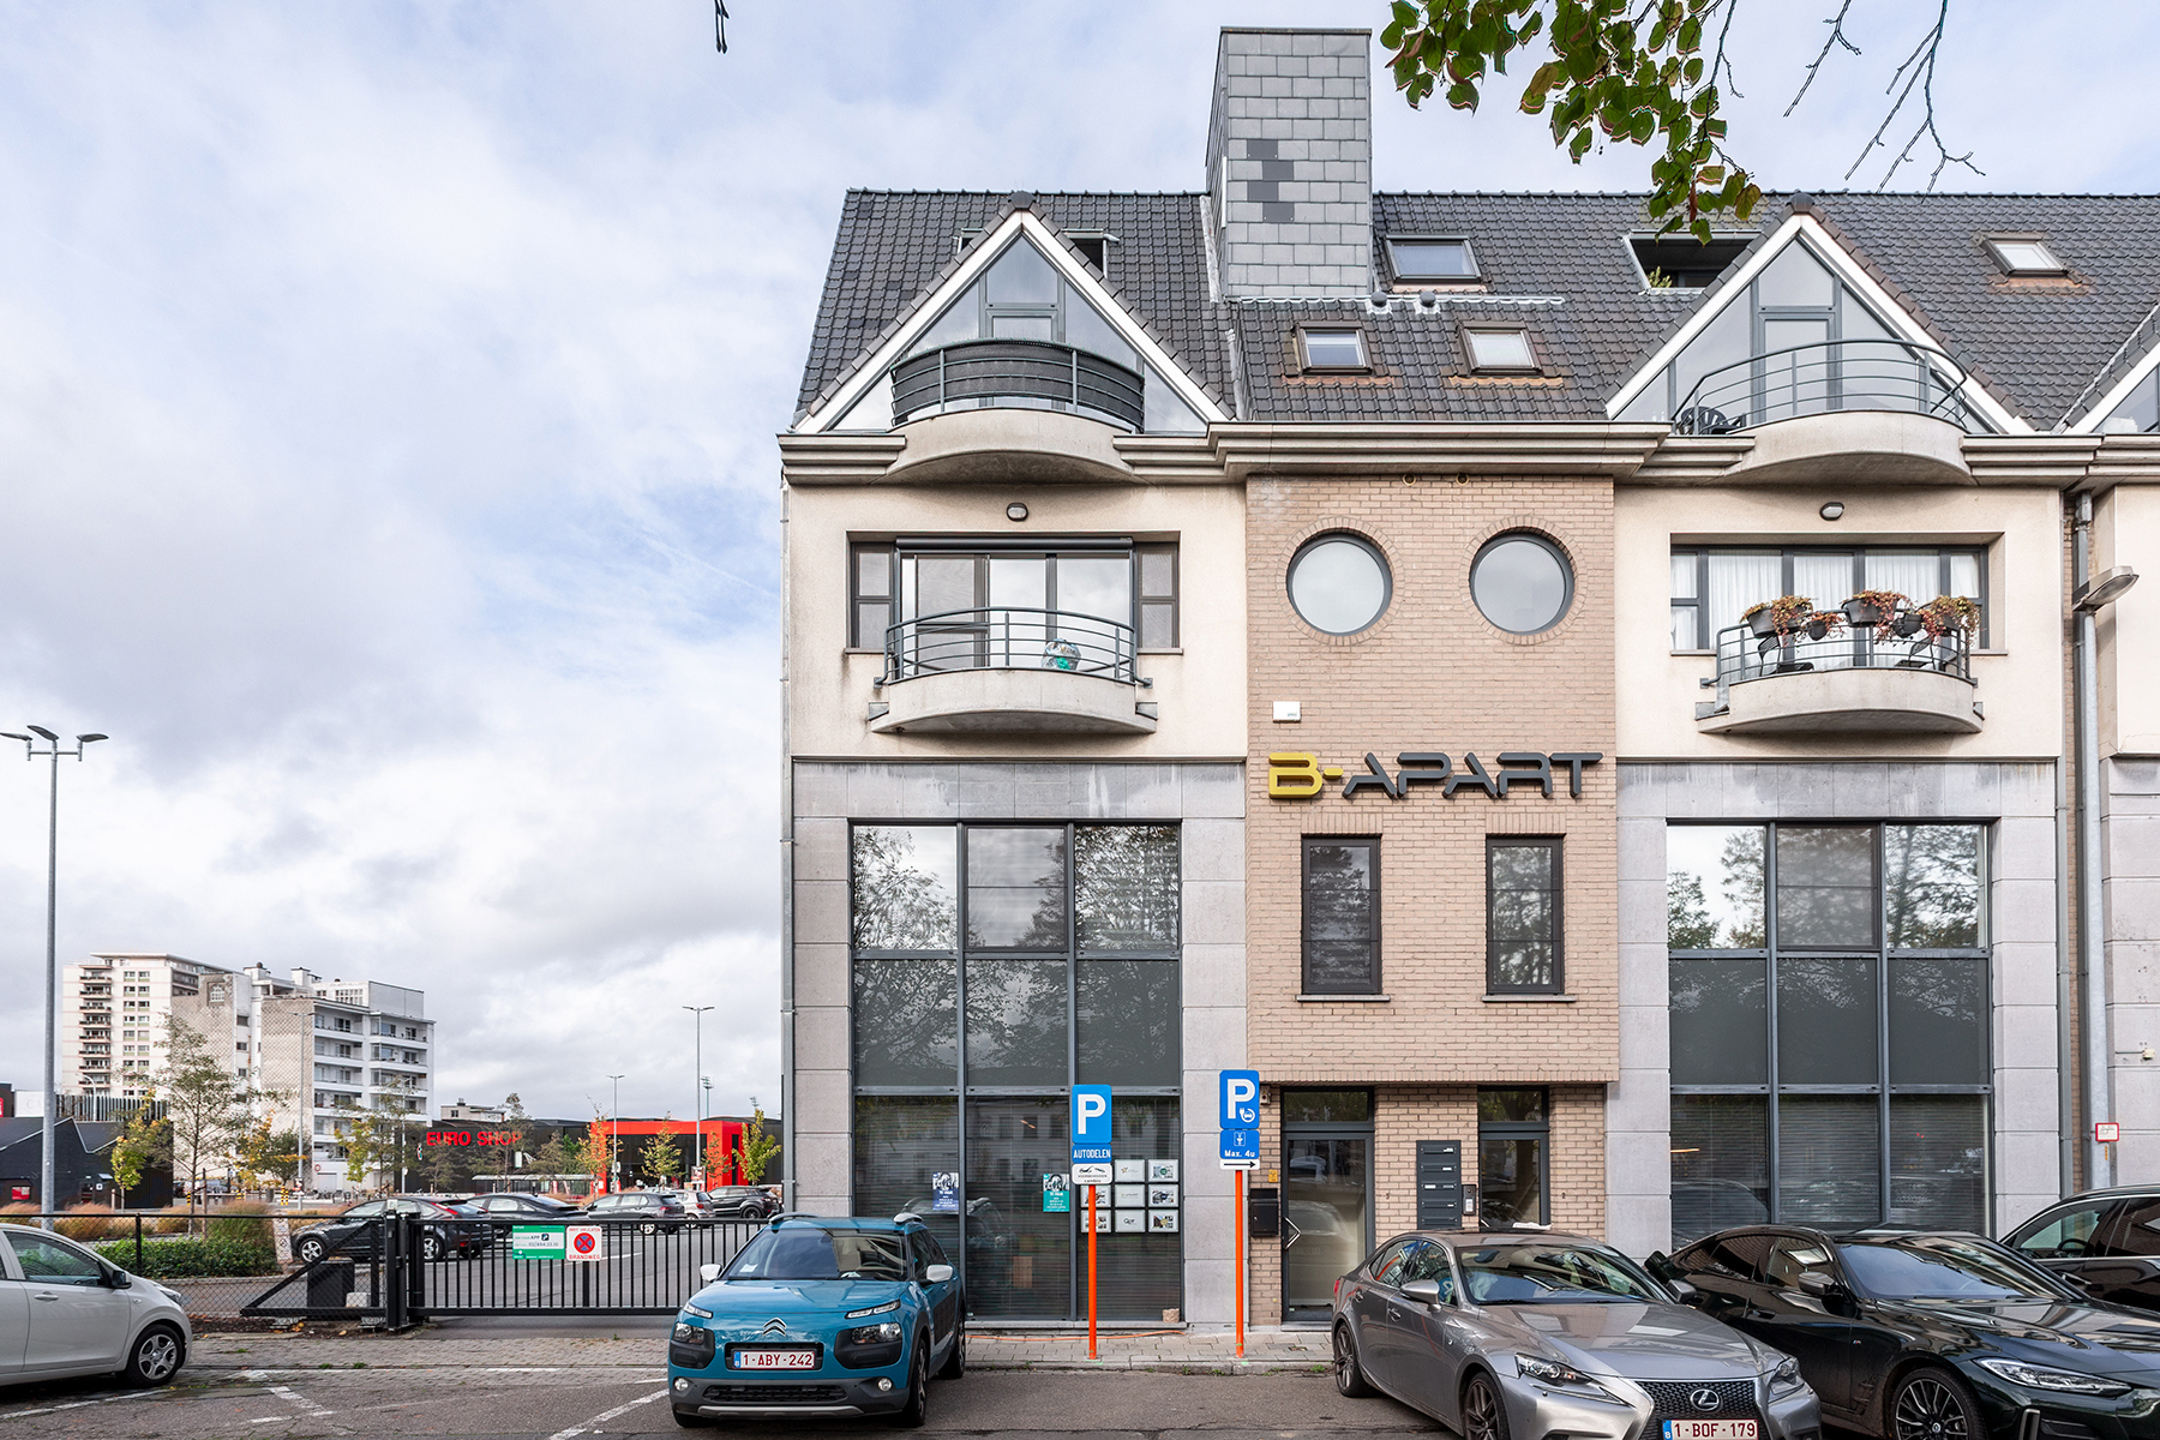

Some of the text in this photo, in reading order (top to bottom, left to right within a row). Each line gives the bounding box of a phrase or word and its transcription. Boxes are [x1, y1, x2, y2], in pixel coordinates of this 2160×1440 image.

[1268, 752, 1603, 799] B-APART
[1078, 1094, 1106, 1134] P
[1227, 1079, 1255, 1119] P
[426, 1131, 522, 1146] EURO SHOP
[1073, 1149, 1111, 1159] AUTODELEN
